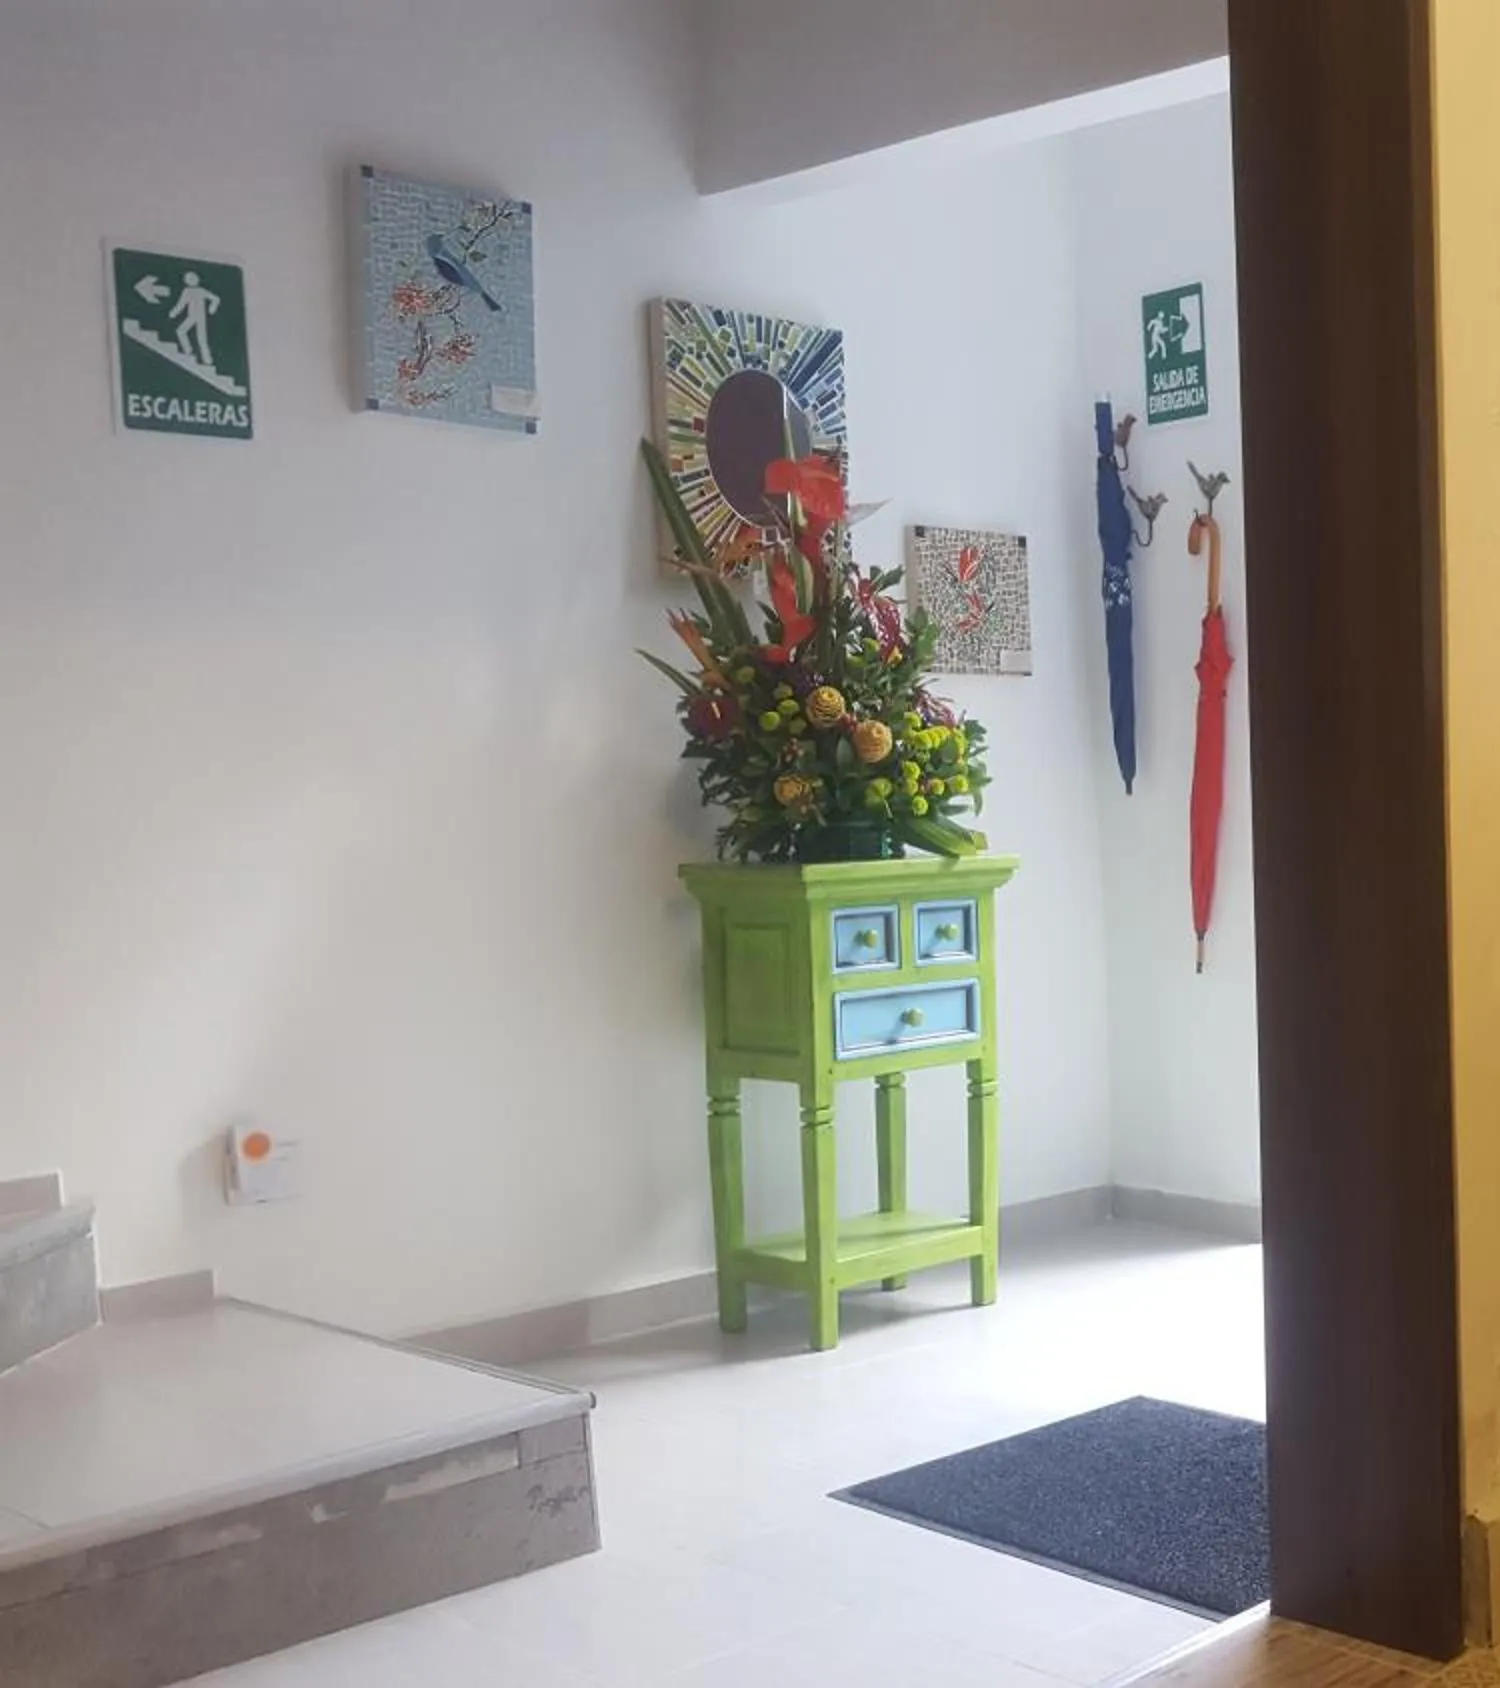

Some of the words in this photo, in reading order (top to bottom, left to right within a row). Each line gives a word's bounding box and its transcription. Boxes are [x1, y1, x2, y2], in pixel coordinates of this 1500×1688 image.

[1153, 367, 1184, 393] SALIDA
[1185, 364, 1199, 385] DE
[127, 393, 249, 427] ESCALERAS
[1149, 386, 1206, 415] EMERGENCIA
